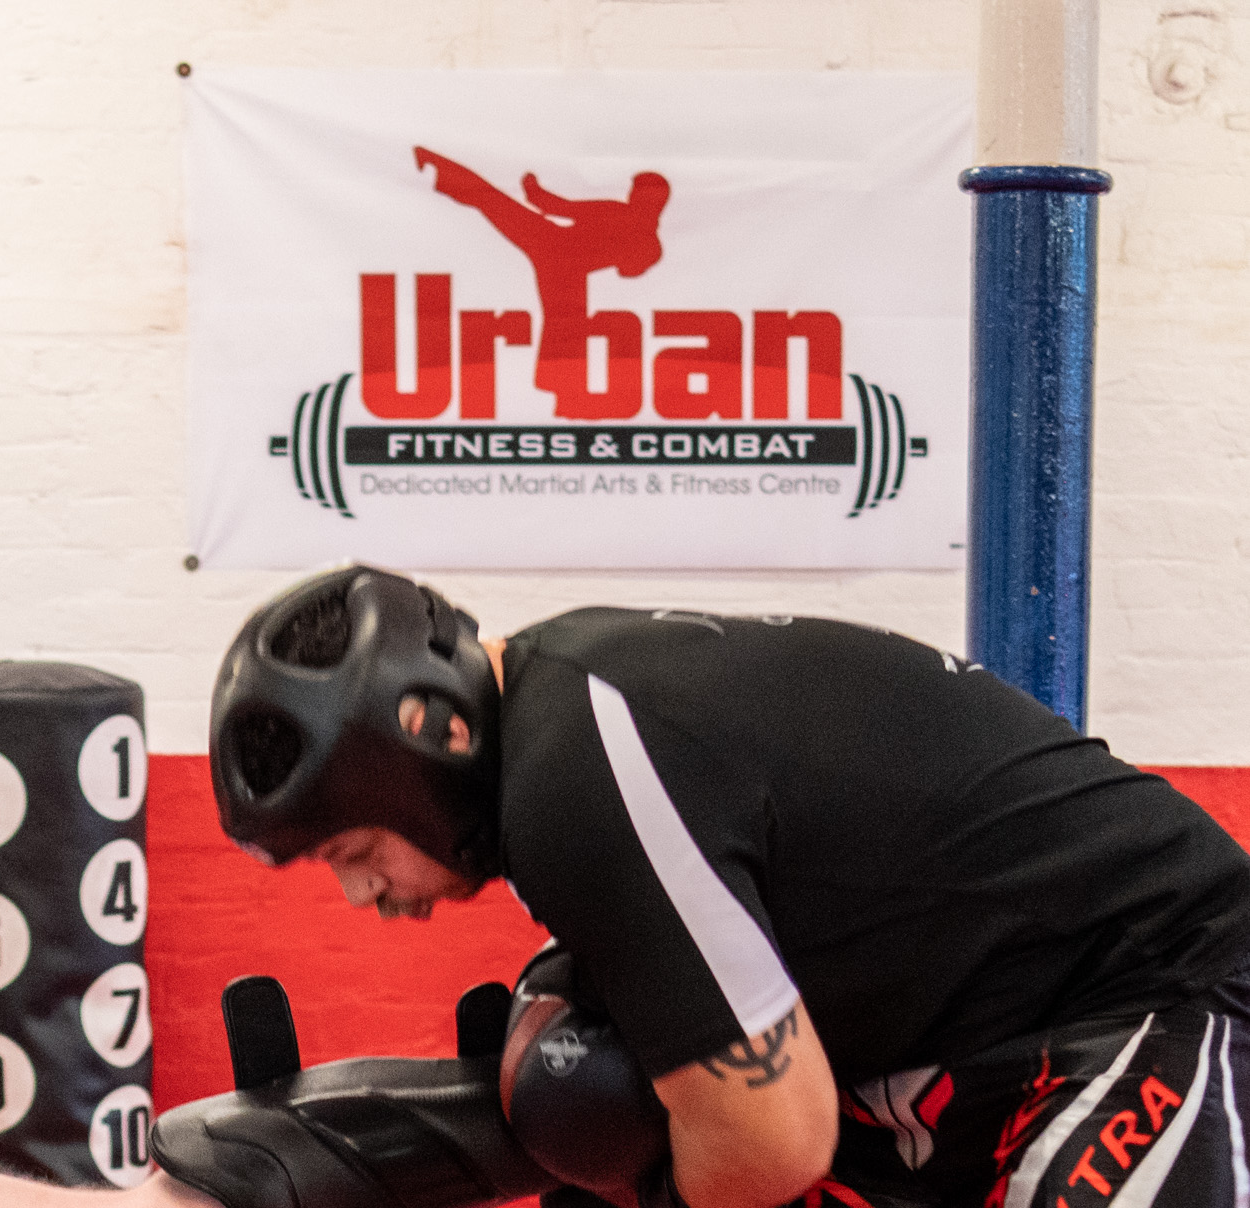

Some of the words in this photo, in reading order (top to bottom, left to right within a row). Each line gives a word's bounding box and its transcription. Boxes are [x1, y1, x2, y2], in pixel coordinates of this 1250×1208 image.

[360, 272, 844, 421] Urban
[387, 433, 578, 459] FITNESS
[589, 433, 619, 459] &
[631, 433, 816, 459] COMBAT
[360, 472, 491, 495] Dedicated
[499, 473, 585, 495] Martial
[591, 472, 638, 495] Arts
[645, 473, 662, 495] &
[671, 472, 750, 495] Fitness
[758, 472, 842, 495] Centre
[111, 736, 131, 800] 1
[101, 860, 139, 923] 4
[111, 987, 143, 1051] 7
[100, 1105, 150, 1170] 10
